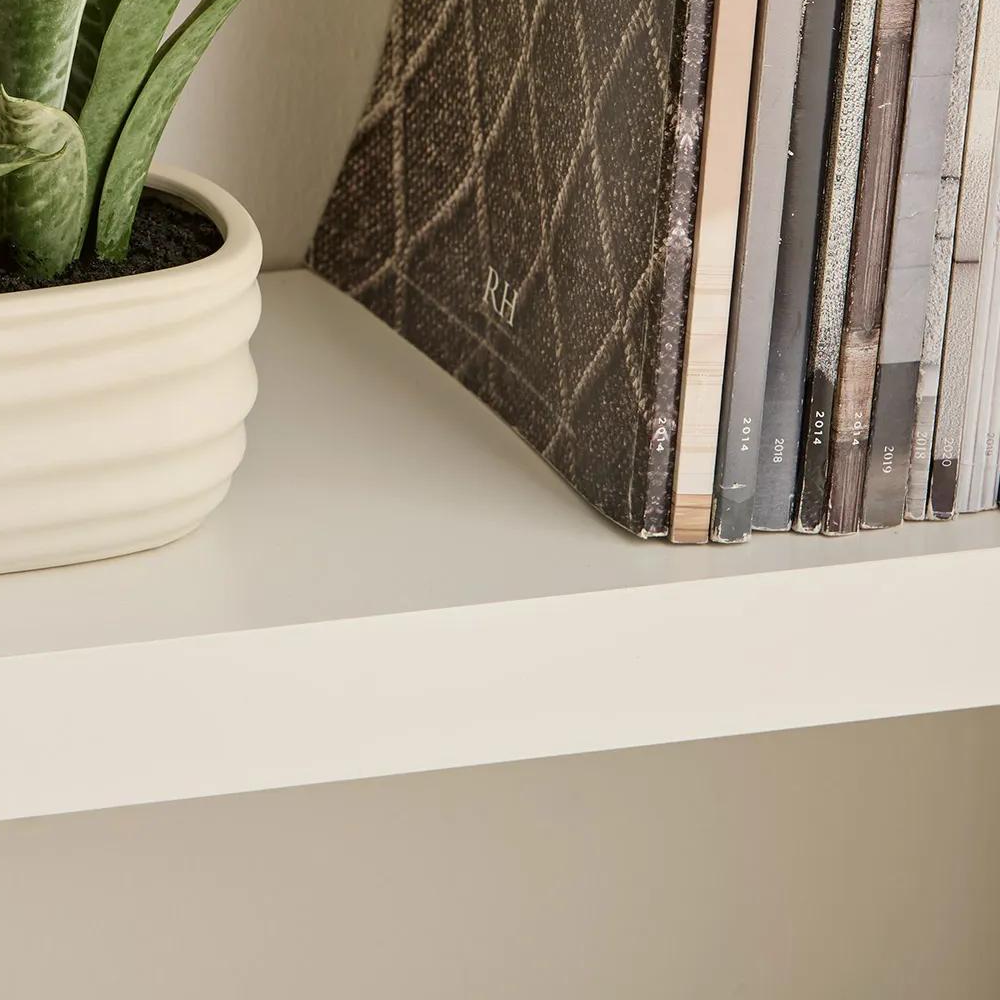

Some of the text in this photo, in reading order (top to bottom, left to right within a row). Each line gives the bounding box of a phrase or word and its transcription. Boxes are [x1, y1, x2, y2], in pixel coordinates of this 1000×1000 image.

[482, 265, 518, 328] RH
[656, 417, 667, 452] 2014
[741, 417, 752, 451] 2014
[813, 410, 825, 445] 2014
[852, 412, 863, 446] 2014
[773, 438, 785, 464] 2018
[882, 446, 894, 473] 2019
[915, 431, 927, 459] 2018
[942, 438, 954, 467] 2020
